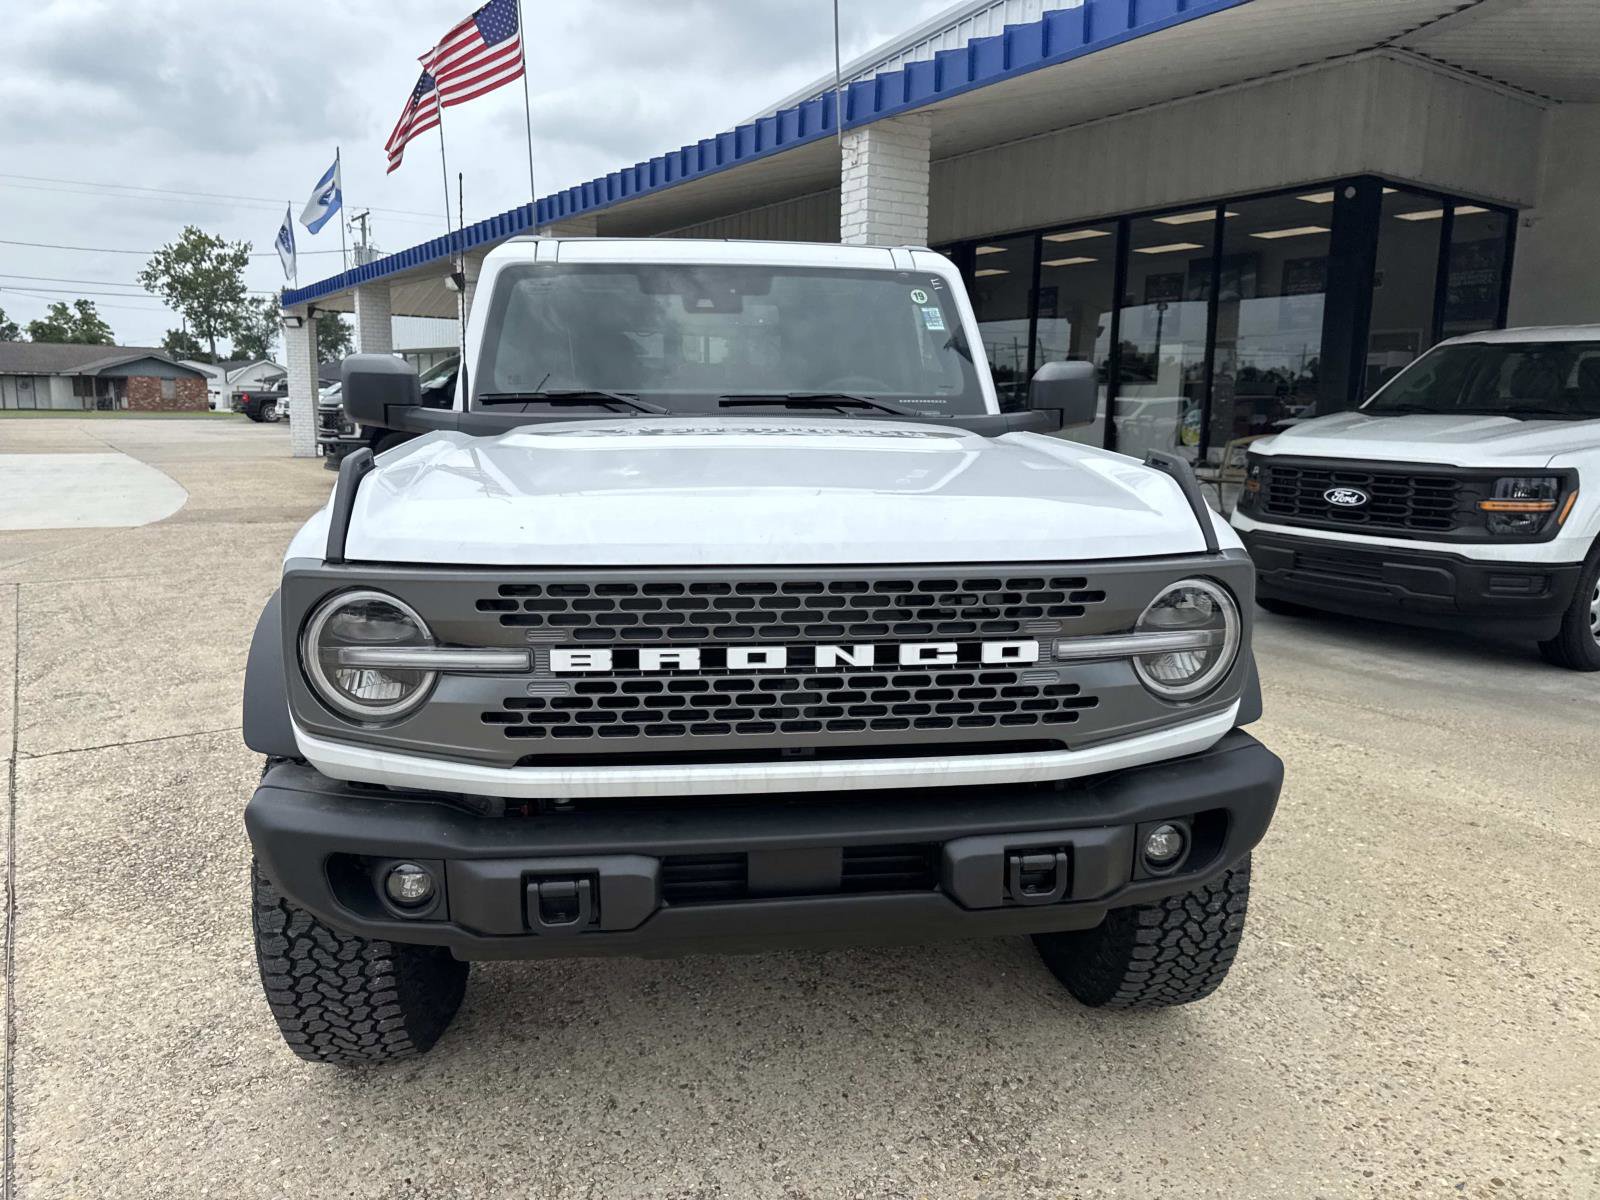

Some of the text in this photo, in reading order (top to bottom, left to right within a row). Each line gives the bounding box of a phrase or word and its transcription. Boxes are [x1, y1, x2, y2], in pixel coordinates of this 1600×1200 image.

[913, 291, 925, 301] 19
[1331, 490, 1359, 503] Ford
[549, 640, 1039, 672] BRONCO
